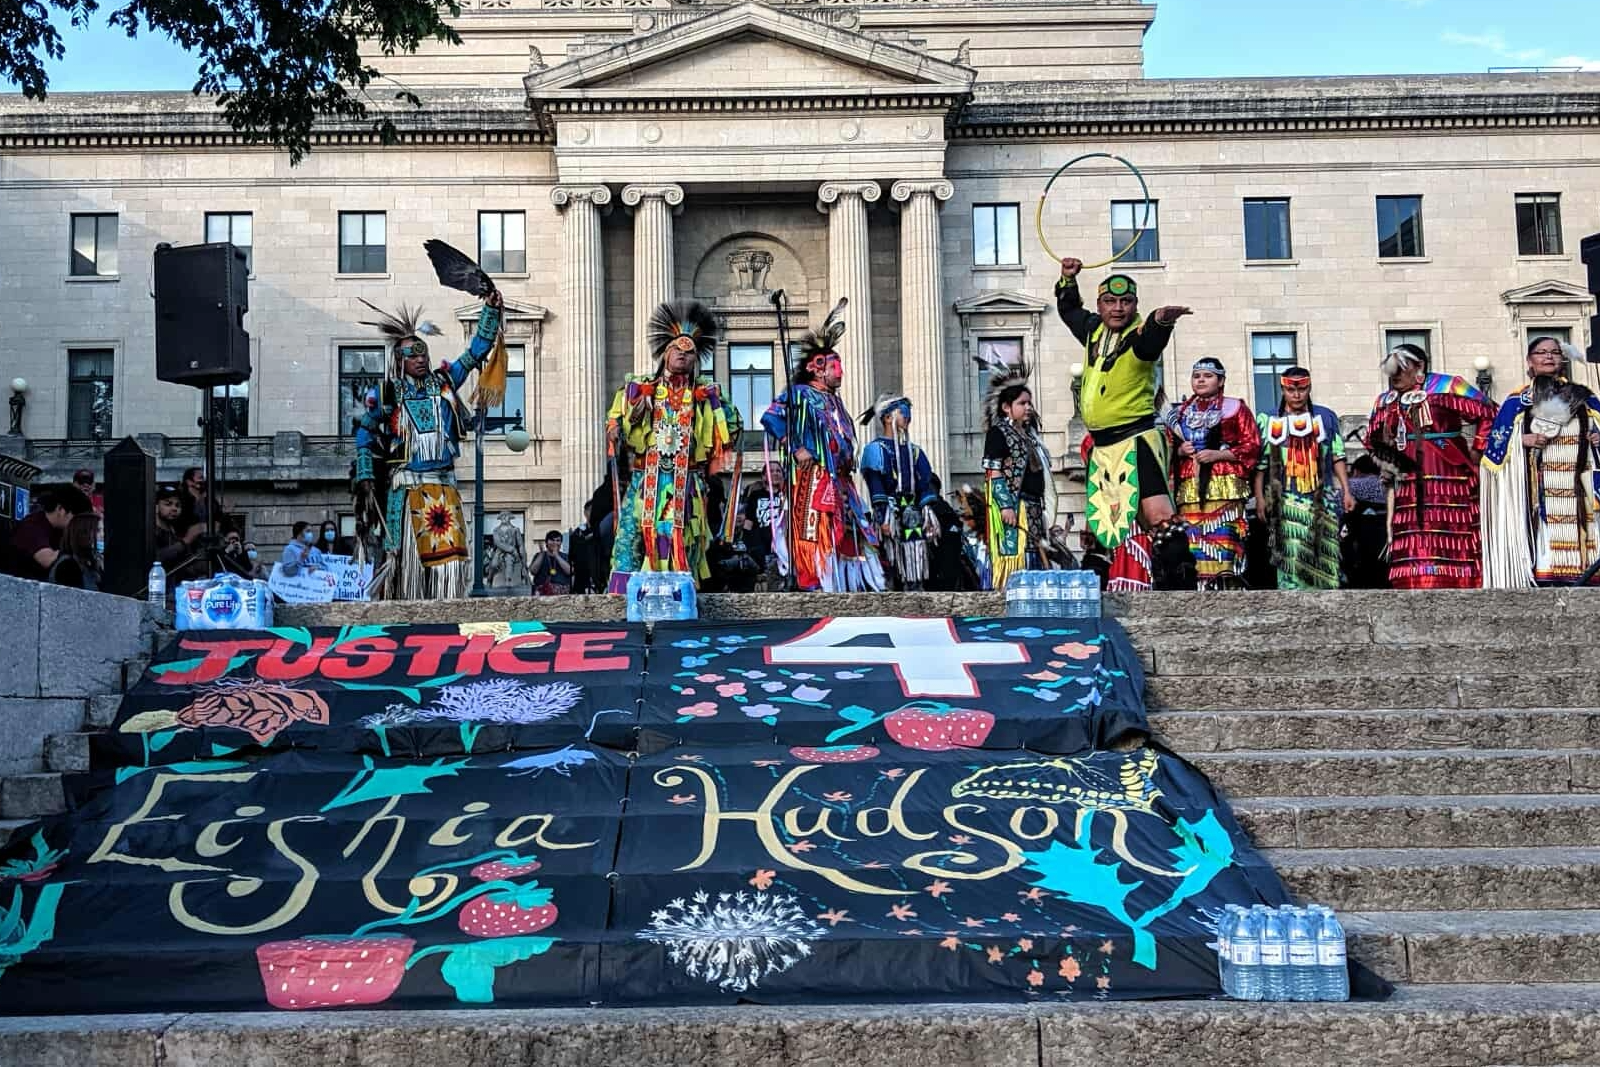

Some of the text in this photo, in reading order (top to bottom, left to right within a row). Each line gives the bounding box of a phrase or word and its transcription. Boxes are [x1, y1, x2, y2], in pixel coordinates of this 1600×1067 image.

[343, 569, 359, 579] NO
[206, 601, 225, 610] Pure
[225, 600, 241, 611] Life
[152, 616, 1031, 697] JUSTICE 4
[88, 764, 1198, 934] Eishia Hudson
